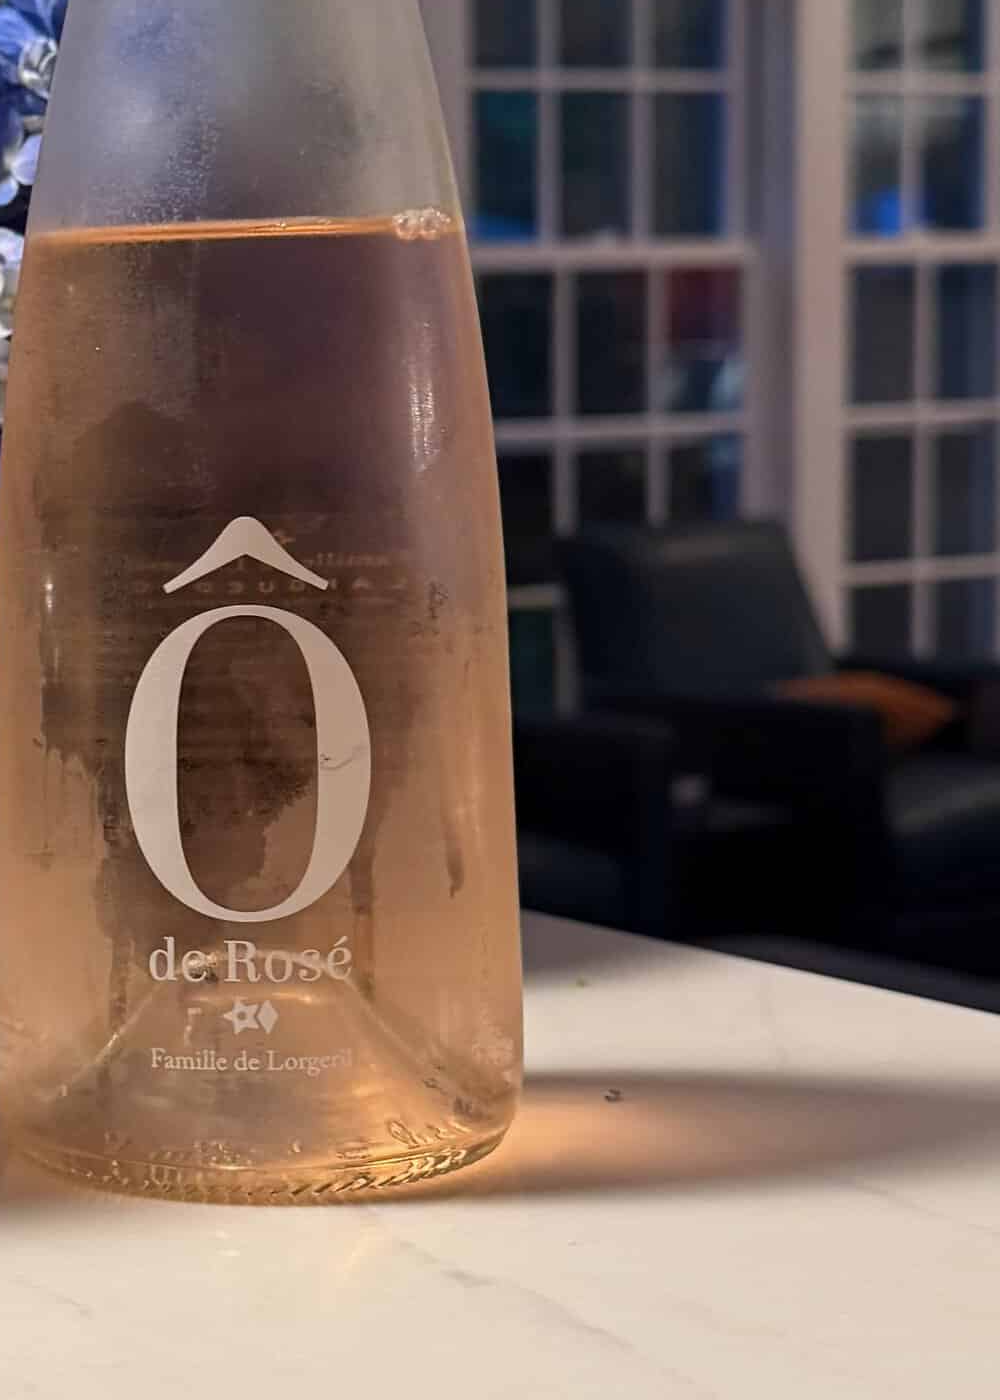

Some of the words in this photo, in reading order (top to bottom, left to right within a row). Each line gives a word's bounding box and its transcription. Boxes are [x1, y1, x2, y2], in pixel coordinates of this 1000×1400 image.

[125, 516, 372, 923] Ô
[150, 936, 208, 982] de
[223, 935, 352, 983] Rosé
[151, 1047, 228, 1071] Famille
[233, 1050, 261, 1071] de
